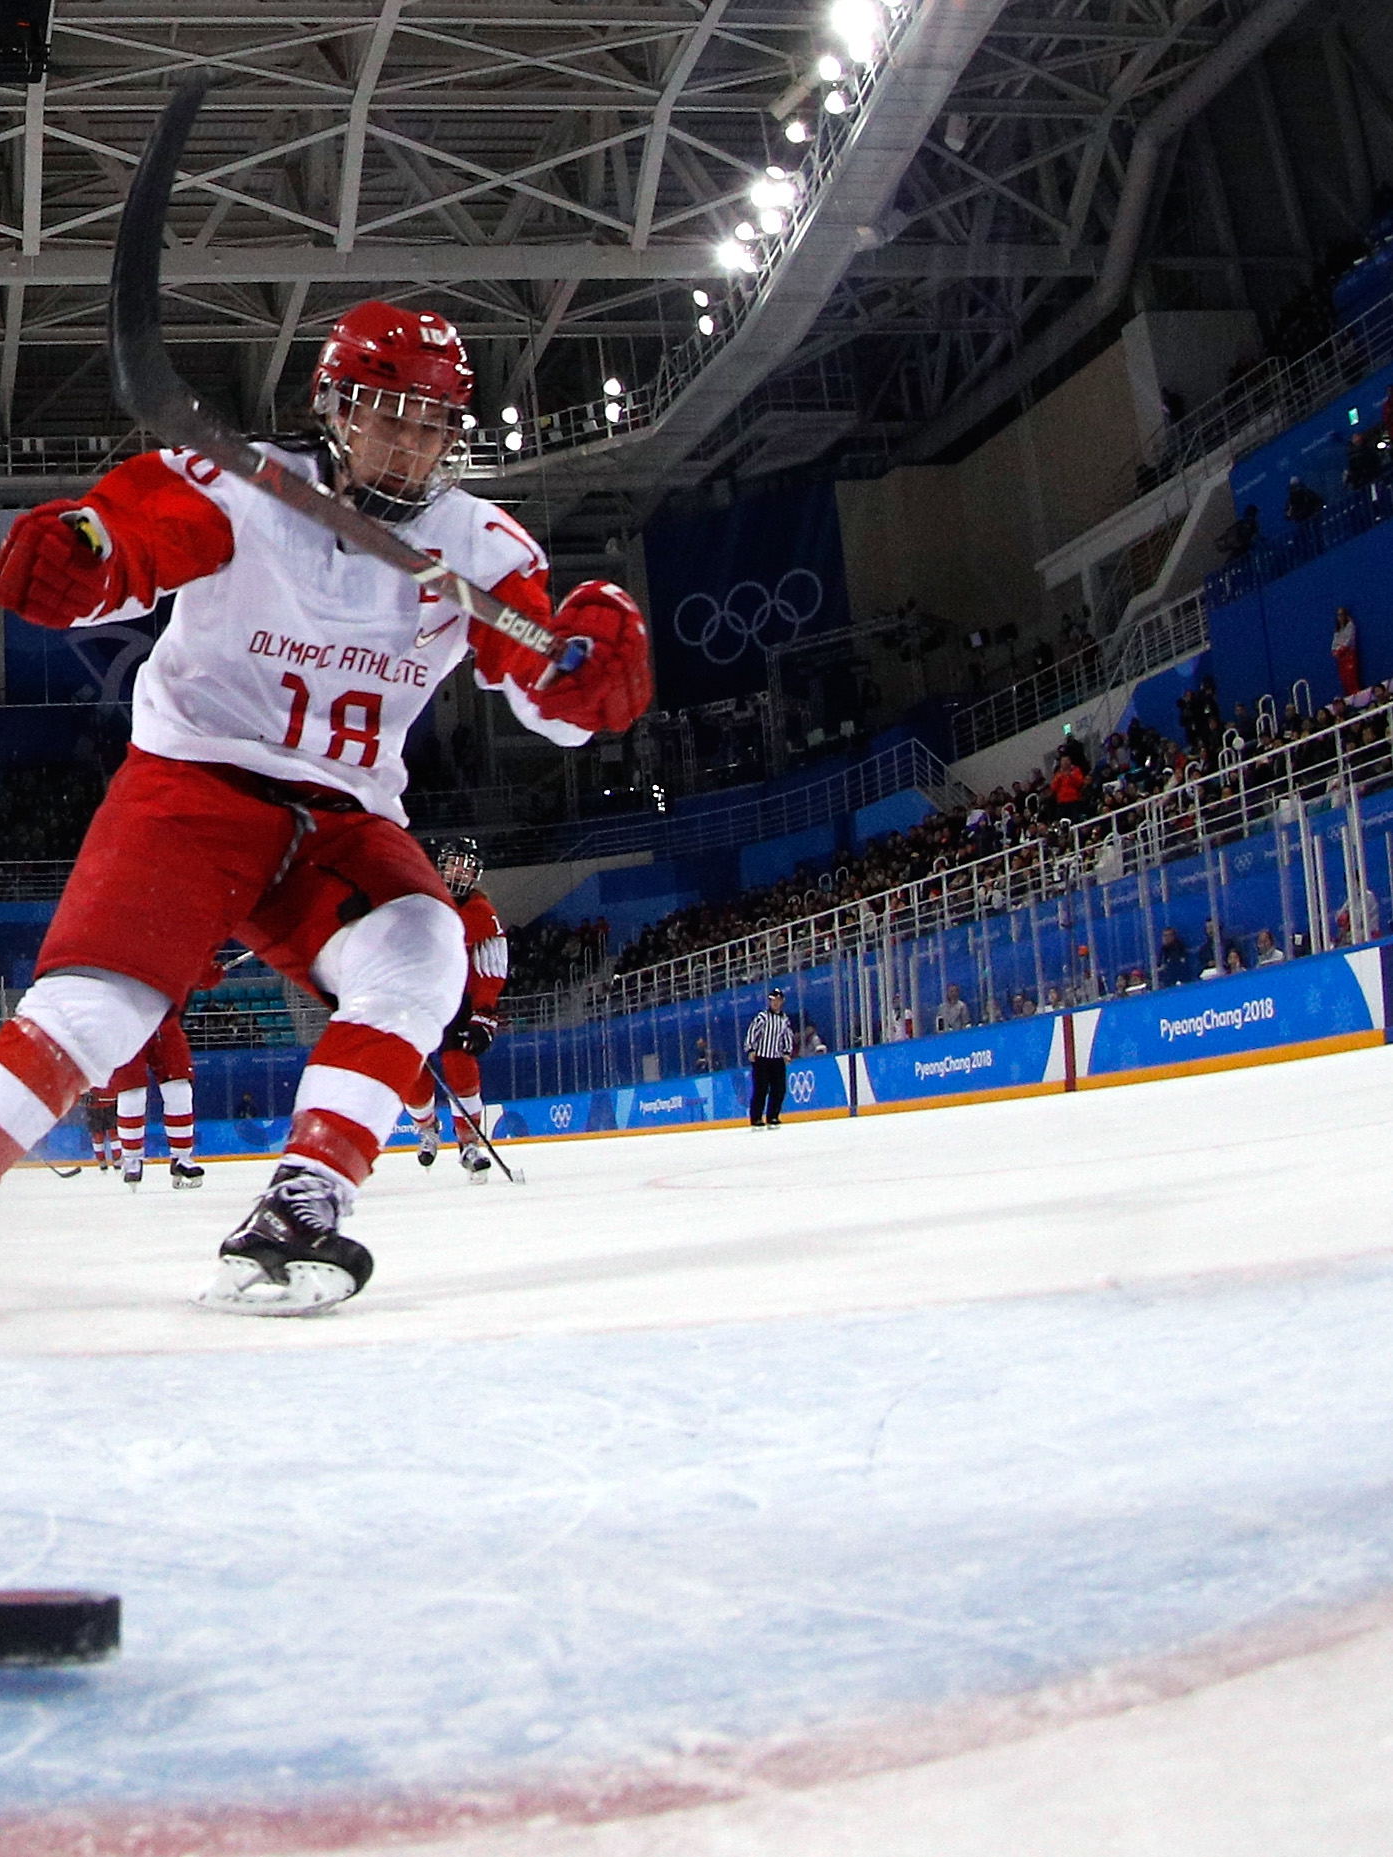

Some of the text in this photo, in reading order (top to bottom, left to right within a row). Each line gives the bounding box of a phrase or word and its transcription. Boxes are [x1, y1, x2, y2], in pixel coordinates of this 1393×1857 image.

[281, 671, 383, 768] 18
[1159, 997, 1274, 1042] PyeongChang 2018
[915, 1049, 992, 1080] PyeongChang 2018
